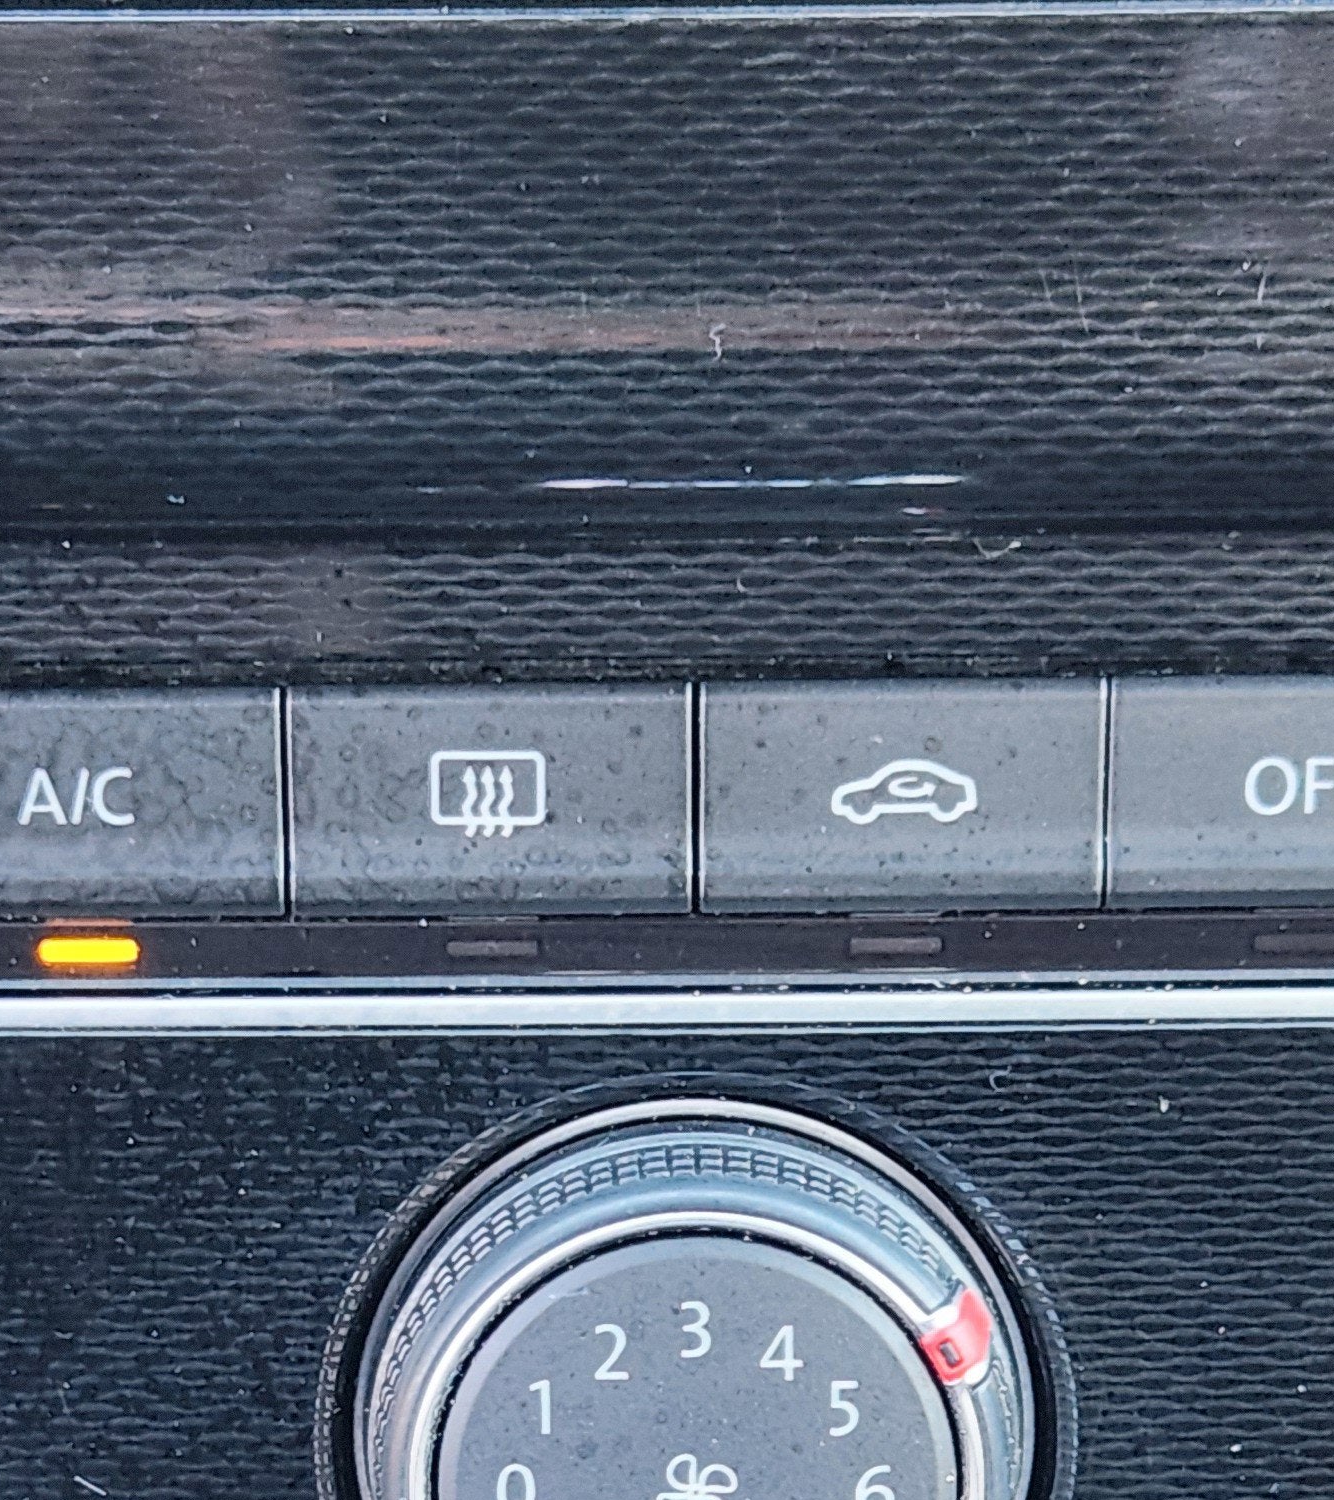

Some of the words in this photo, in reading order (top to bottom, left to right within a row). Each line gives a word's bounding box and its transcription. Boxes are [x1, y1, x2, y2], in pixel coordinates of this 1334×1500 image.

[17, 764, 137, 828] A/C
[593, 1323, 630, 1381] 2
[679, 1300, 712, 1359] 3
[759, 1324, 804, 1382] 4
[529, 1378, 553, 1435] 1
[828, 1379, 859, 1437] 5
